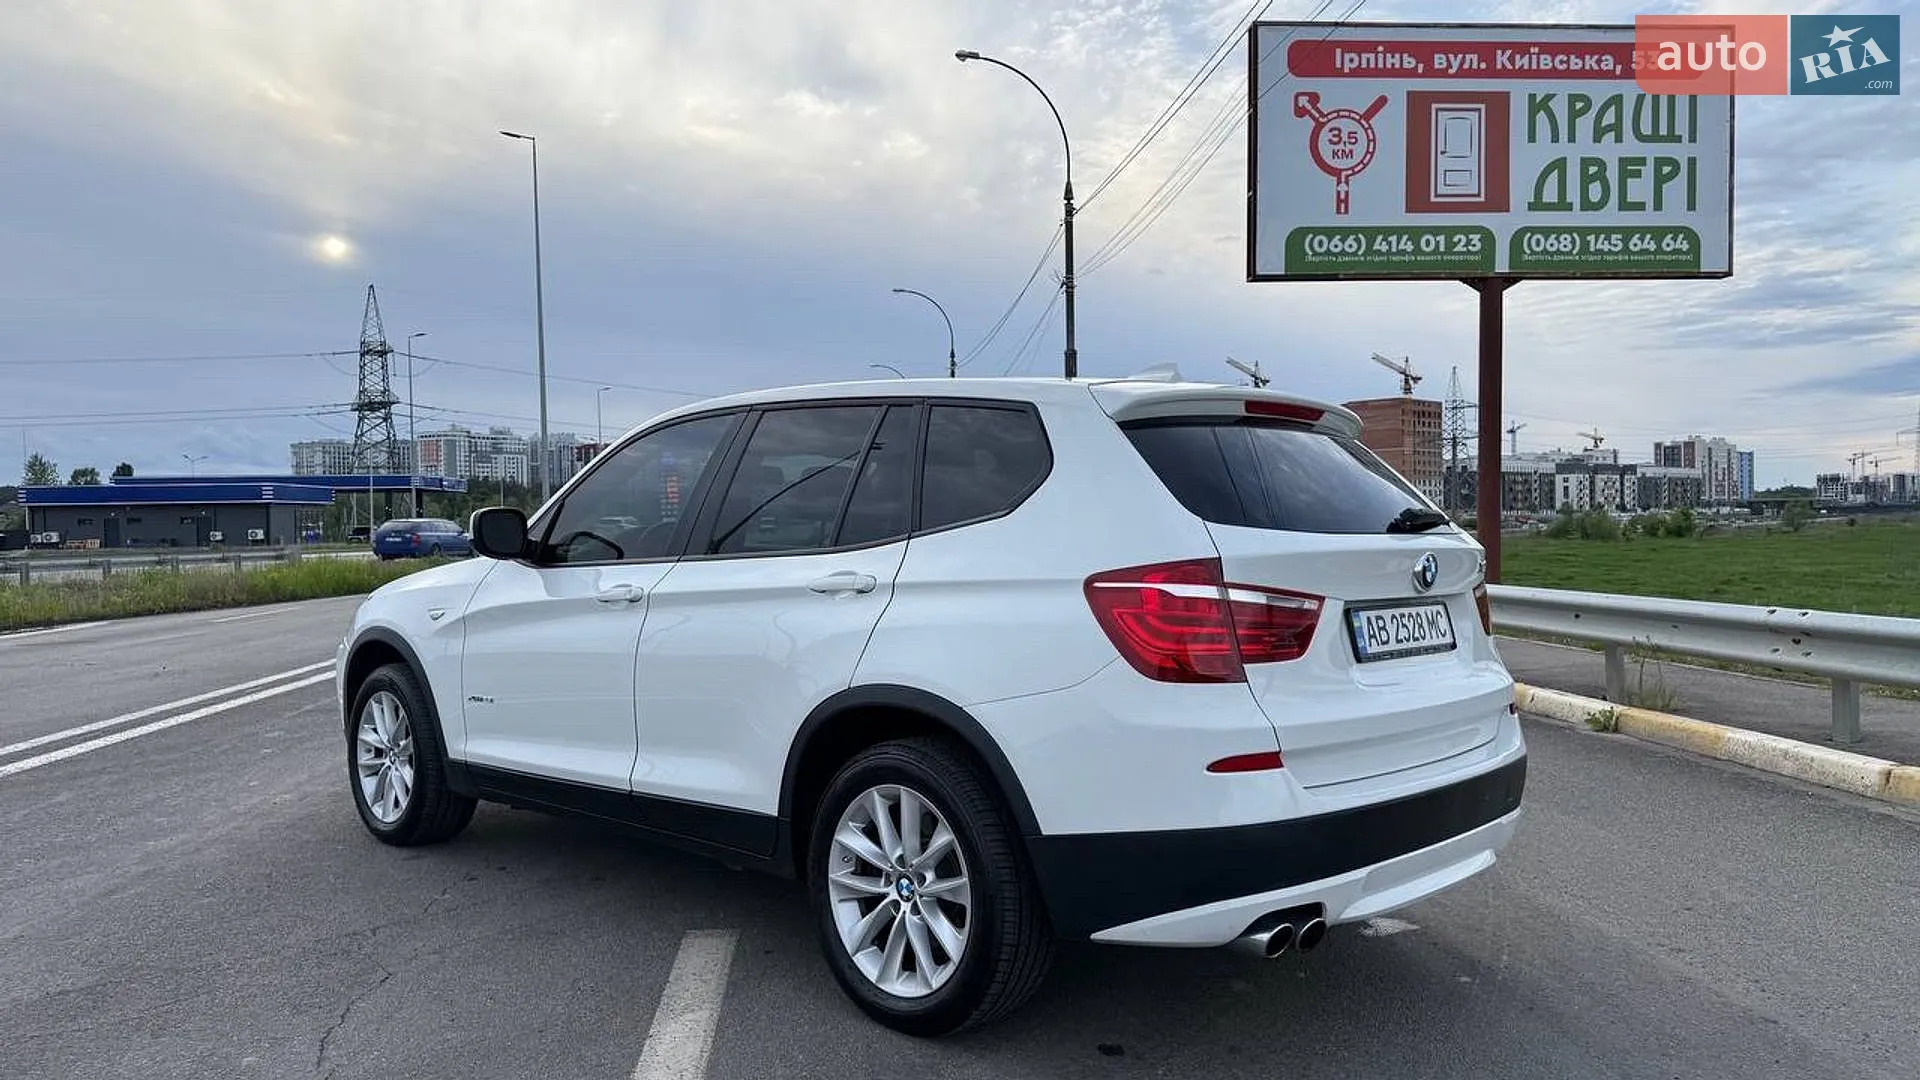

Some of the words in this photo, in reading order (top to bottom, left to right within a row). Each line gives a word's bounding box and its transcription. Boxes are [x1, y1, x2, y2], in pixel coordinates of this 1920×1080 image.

[1334, 45, 1424, 74] Ірпінь,
[1433, 52, 1488, 74] вул.
[1495, 47, 1622, 75] Київська,
[1327, 126, 1359, 147] 3,5
[1527, 156, 1698, 212] ДВЕРІ
[1304, 232, 1367, 255] (066)
[1373, 234, 1415, 252] 414
[1420, 234, 1446, 252] 01
[1452, 234, 1482, 252] 23
[1522, 232, 1581, 254] (068)
[1586, 234, 1623, 252] 145
[1628, 234, 1657, 252] 64
[1661, 233, 1690, 251] 64
[1366, 614, 1391, 647] AB
[1390, 611, 1427, 645] 2528
[1424, 608, 1447, 640] MC
